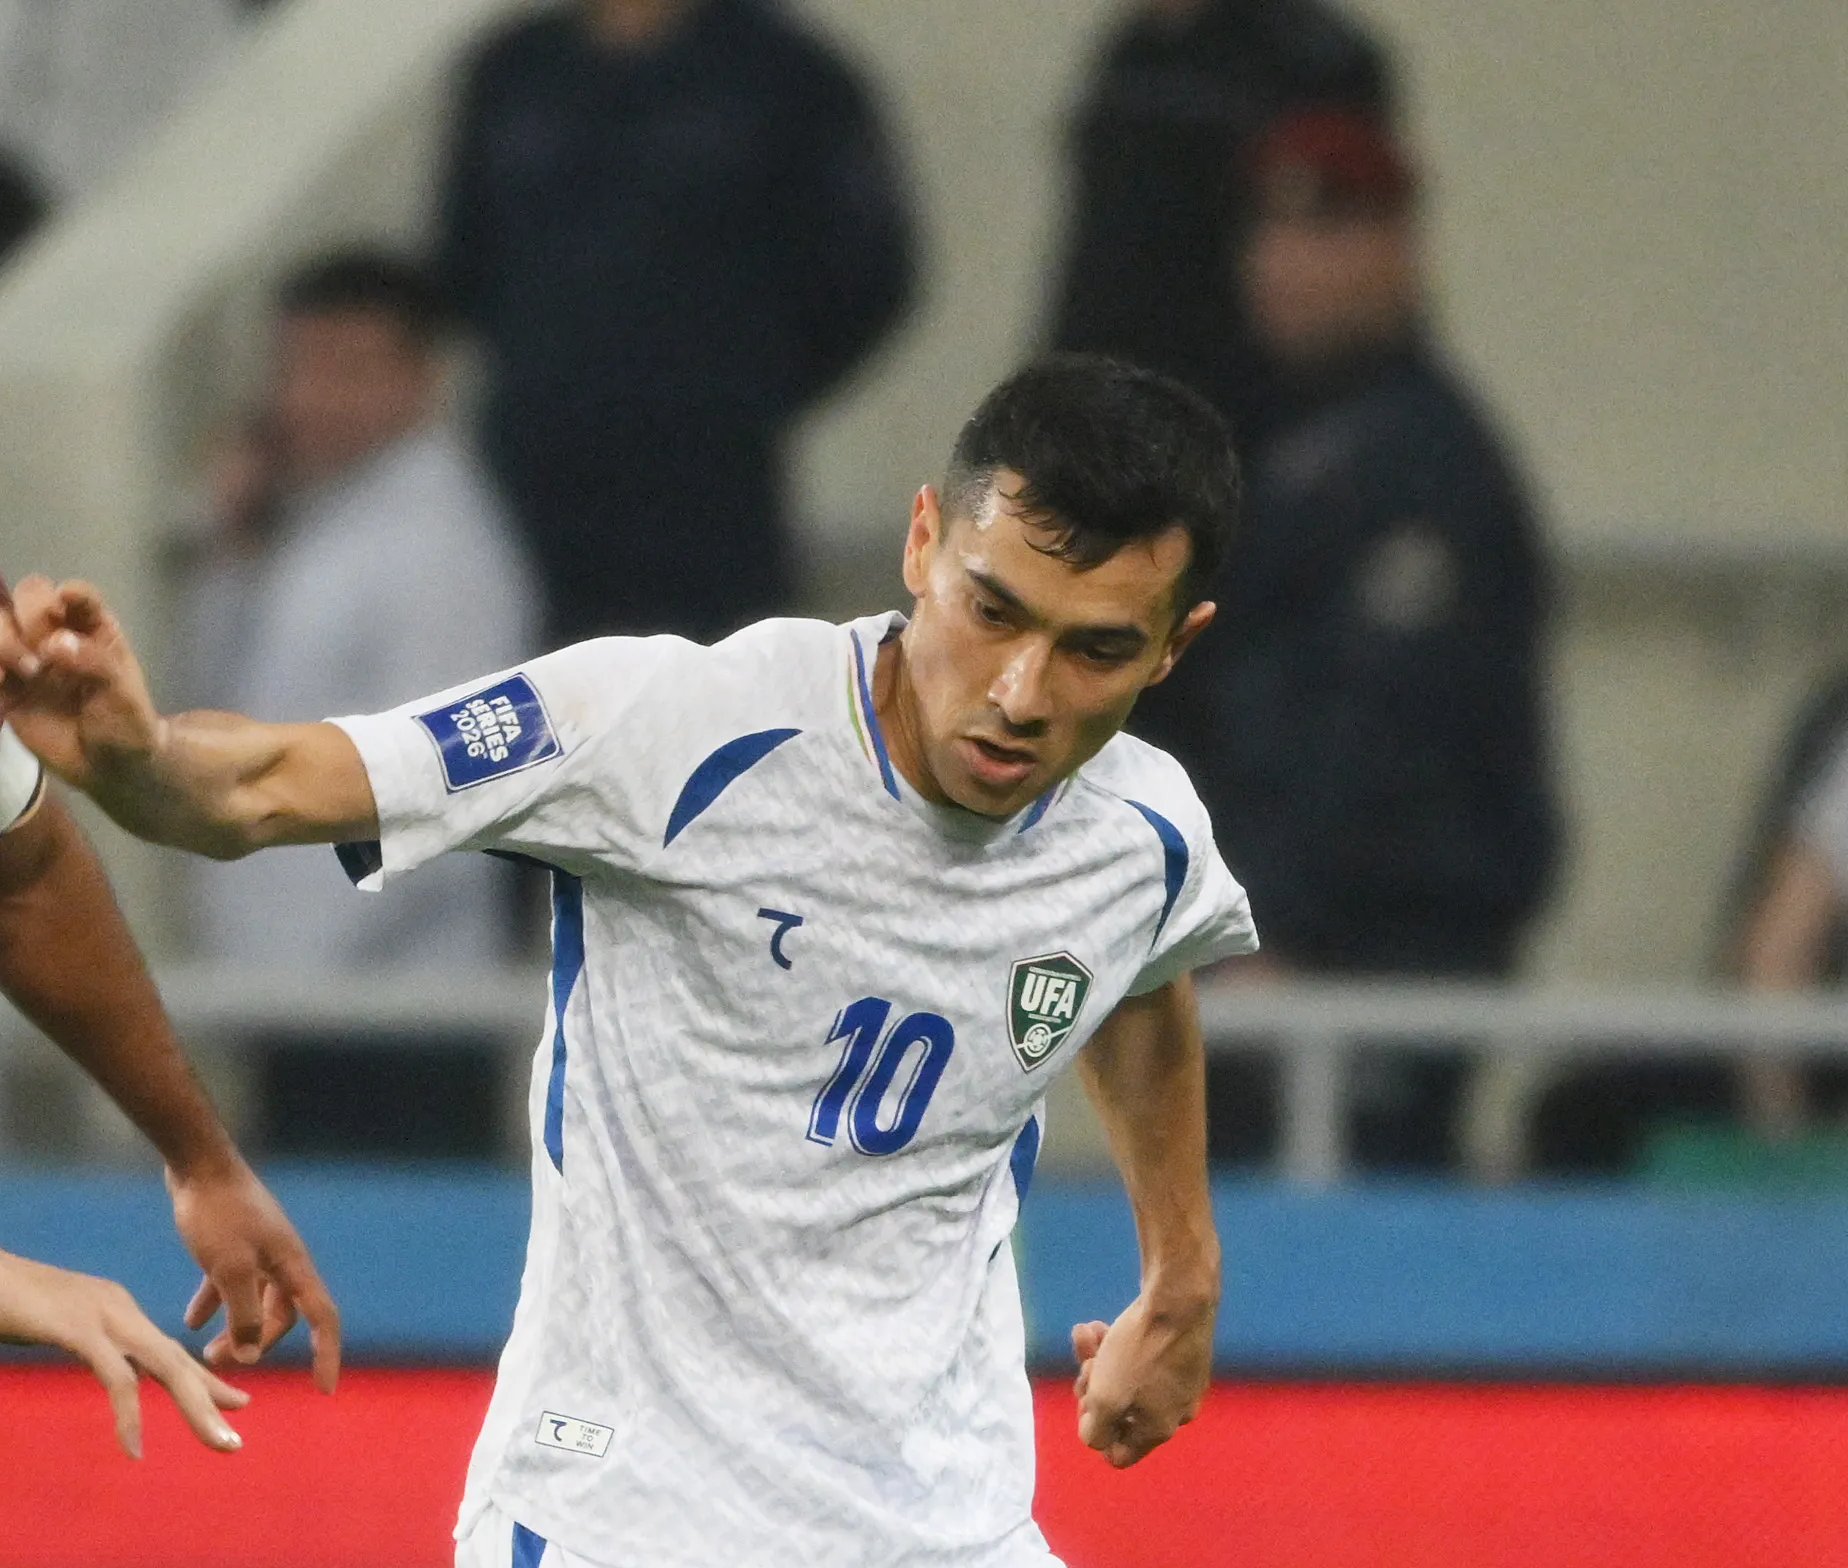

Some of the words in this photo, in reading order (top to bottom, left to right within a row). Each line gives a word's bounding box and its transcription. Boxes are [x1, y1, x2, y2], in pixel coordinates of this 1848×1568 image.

[450, 709, 486, 757] 2026
[465, 699, 509, 762] SERIES
[489, 695, 522, 743] FIFA
[1020, 972, 1077, 1019] UFA
[805, 996, 955, 1157] 10
[576, 1440, 594, 1450] WIN
[579, 1425, 601, 1436] TIME
[582, 1434, 594, 1442] TO
